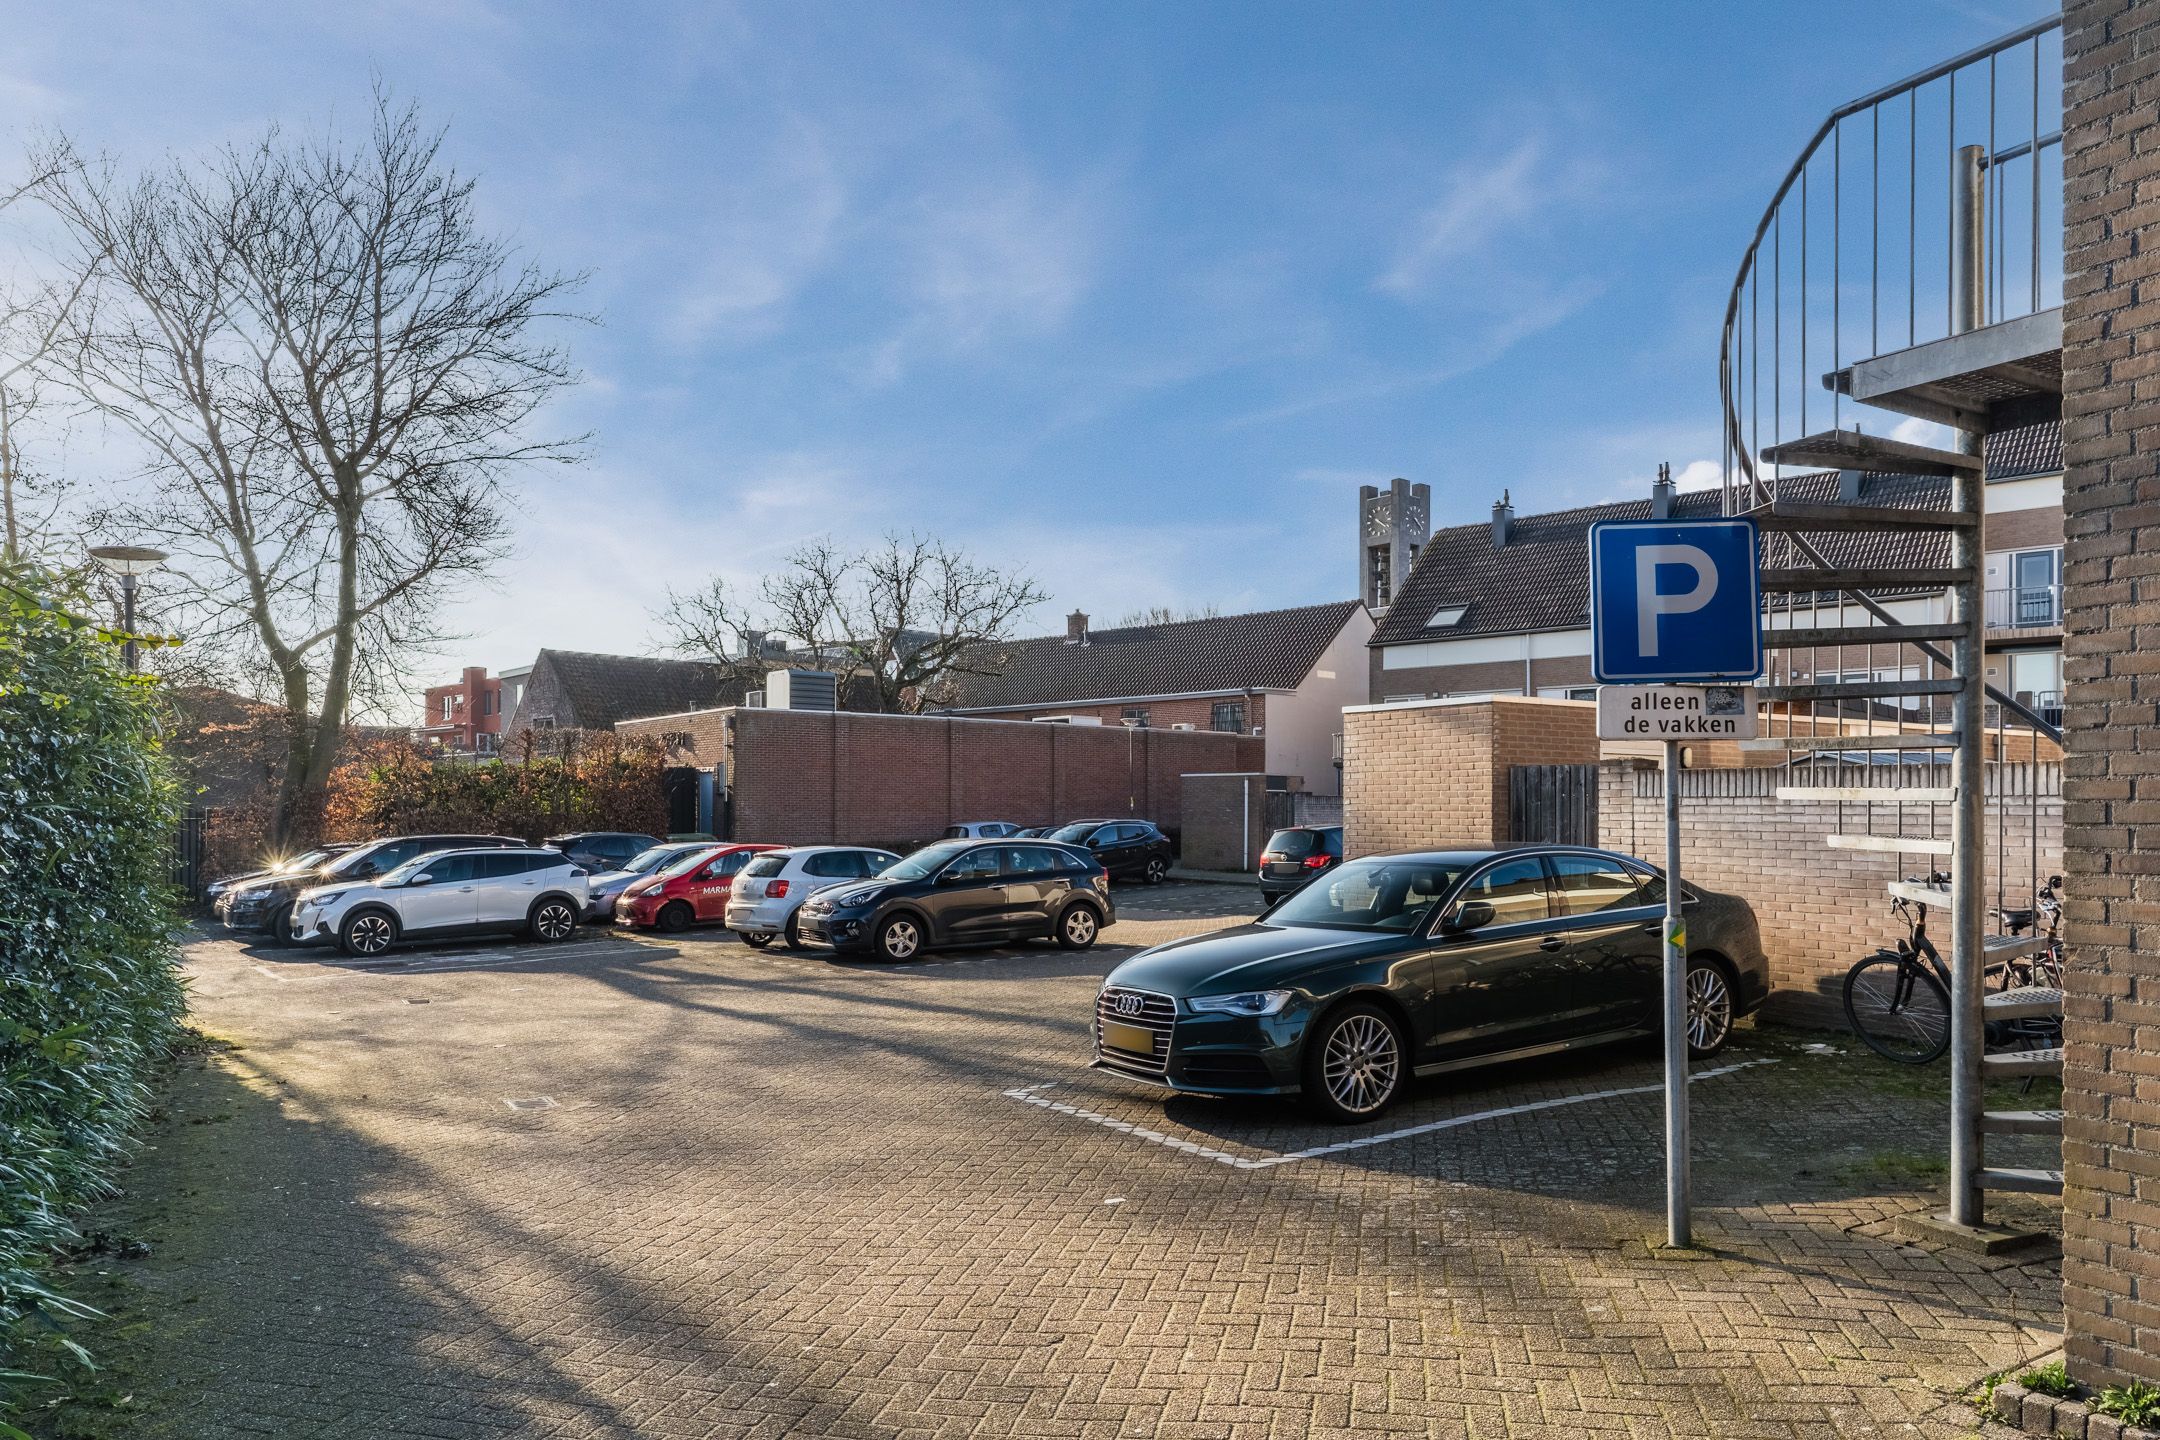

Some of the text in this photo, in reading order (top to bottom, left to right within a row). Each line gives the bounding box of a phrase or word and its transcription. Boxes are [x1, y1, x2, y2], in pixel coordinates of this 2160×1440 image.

[1635, 544, 1719, 657] P
[1631, 692, 1699, 711] alleen
[1624, 716, 1736, 733] de vakken
